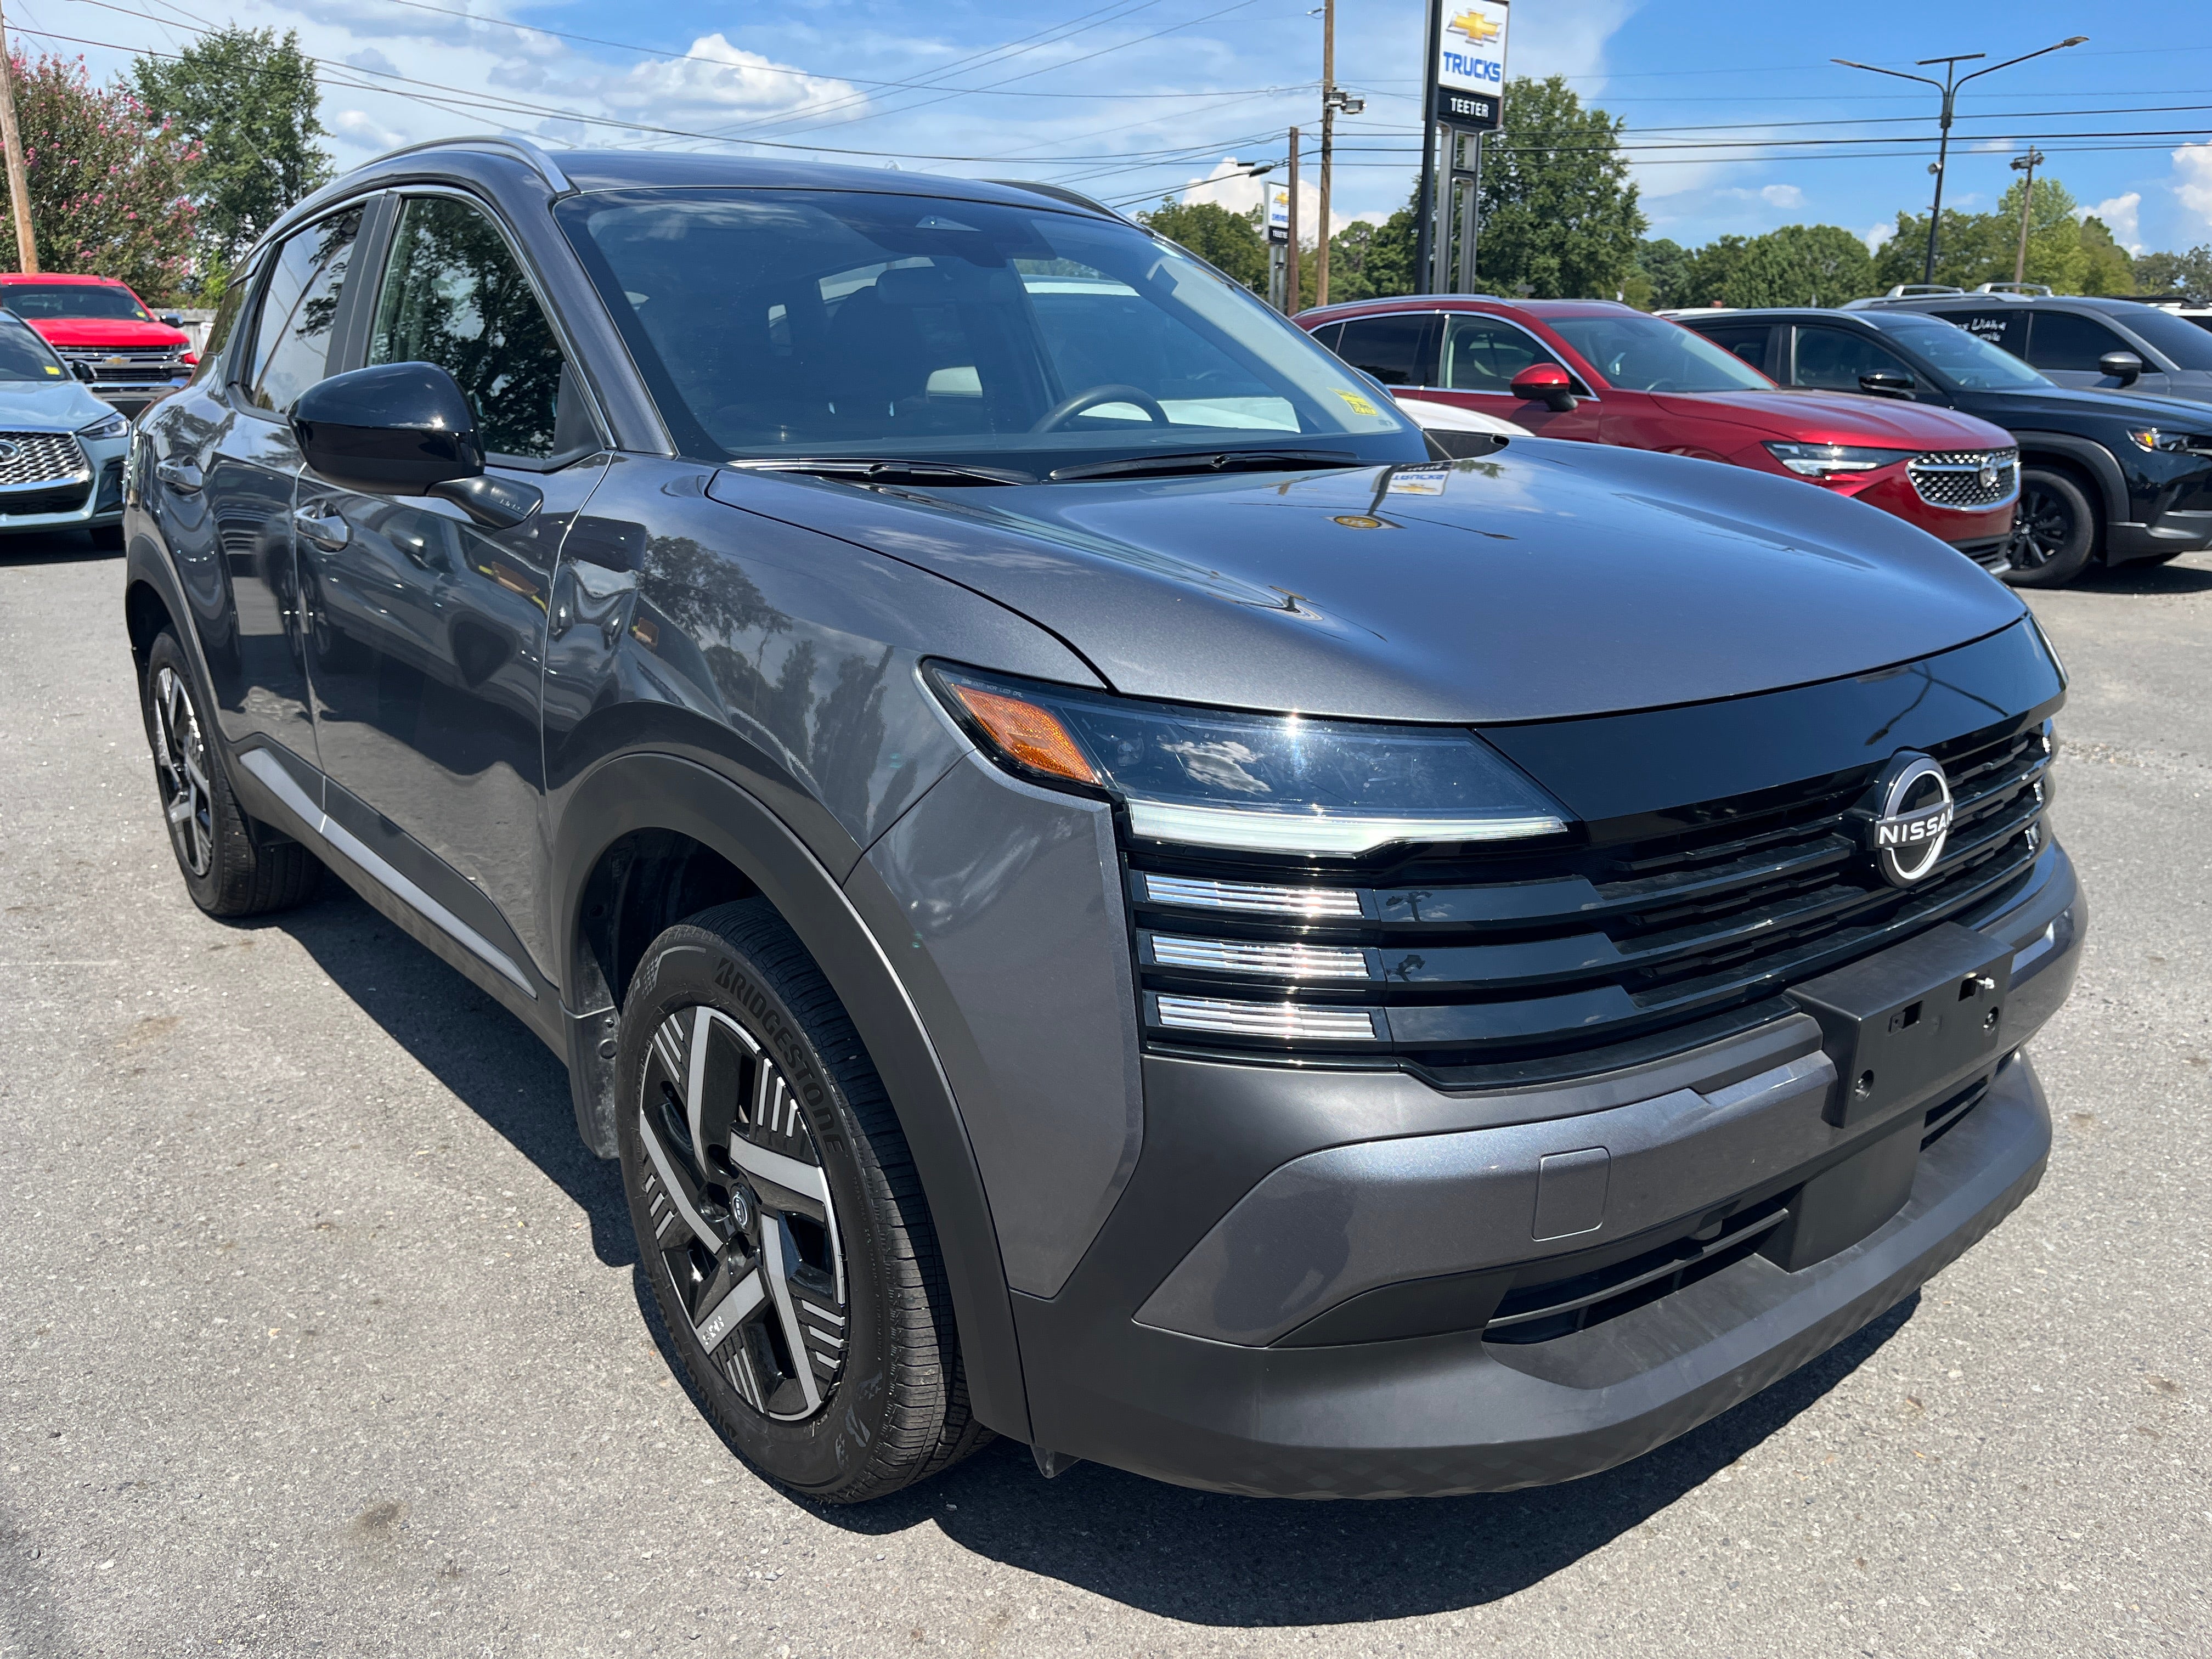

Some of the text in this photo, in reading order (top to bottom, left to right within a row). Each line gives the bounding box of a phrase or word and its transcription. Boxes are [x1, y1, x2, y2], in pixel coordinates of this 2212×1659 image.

[1443, 51, 1501, 83] TRUCKS
[1450, 97, 1489, 118] TEETER
[1878, 808, 1953, 844] NISSAN
[715, 957, 844, 1153] BRIDGESTONE
